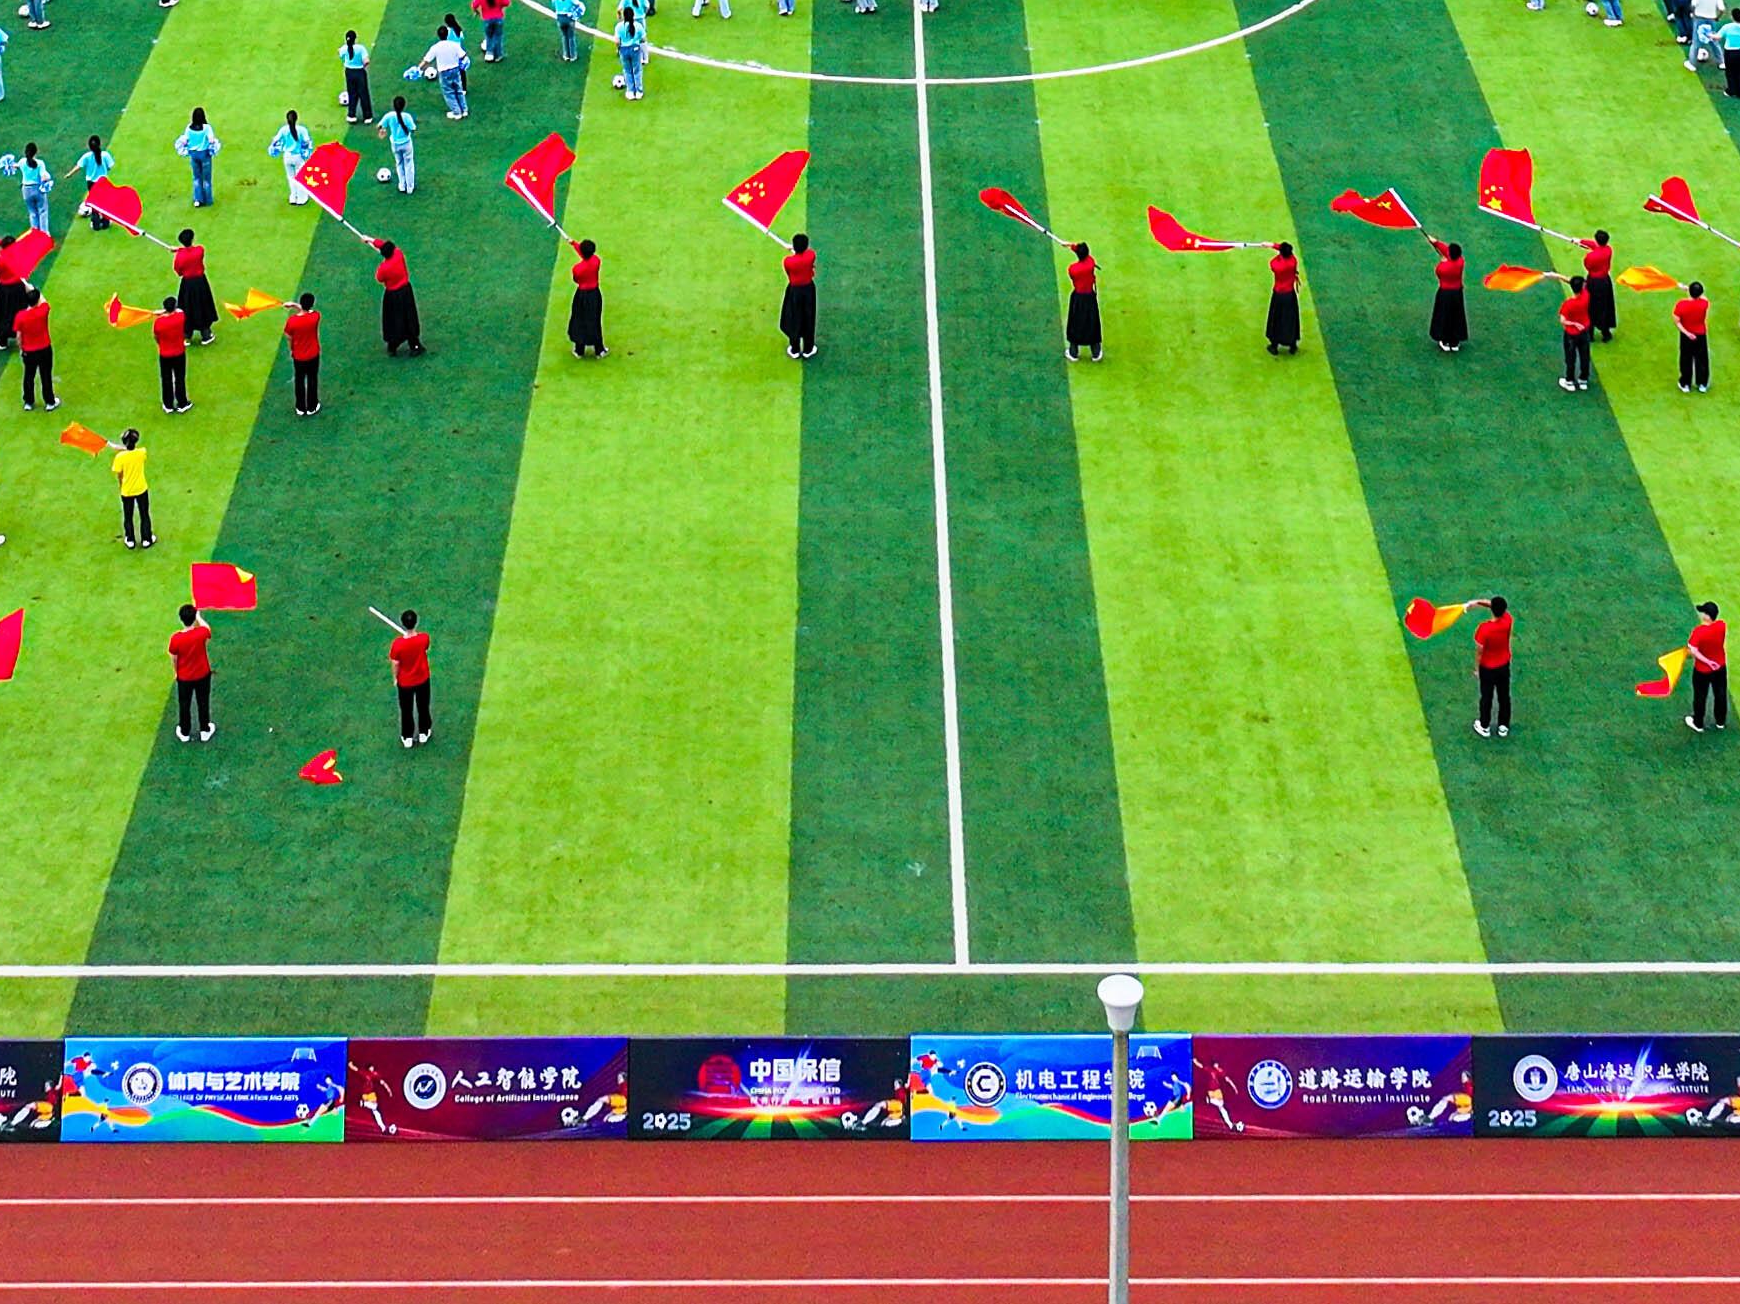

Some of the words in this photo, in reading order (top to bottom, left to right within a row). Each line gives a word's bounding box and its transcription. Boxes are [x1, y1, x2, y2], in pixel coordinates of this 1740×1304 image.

[451, 1065, 582, 1090] 人工智能学院
[749, 1057, 842, 1083] 中国保信
[1298, 1066, 1432, 1090] 道路运输学院
[1563, 1061, 1710, 1082] 唐山海运职业学院
[167, 1071, 300, 1092] 体育与艺术学院
[486, 1093, 495, 1102] of
[1302, 1093, 1328, 1103] Road
[1332, 1093, 1382, 1105] Transport
[1385, 1093, 1431, 1103] Institute
